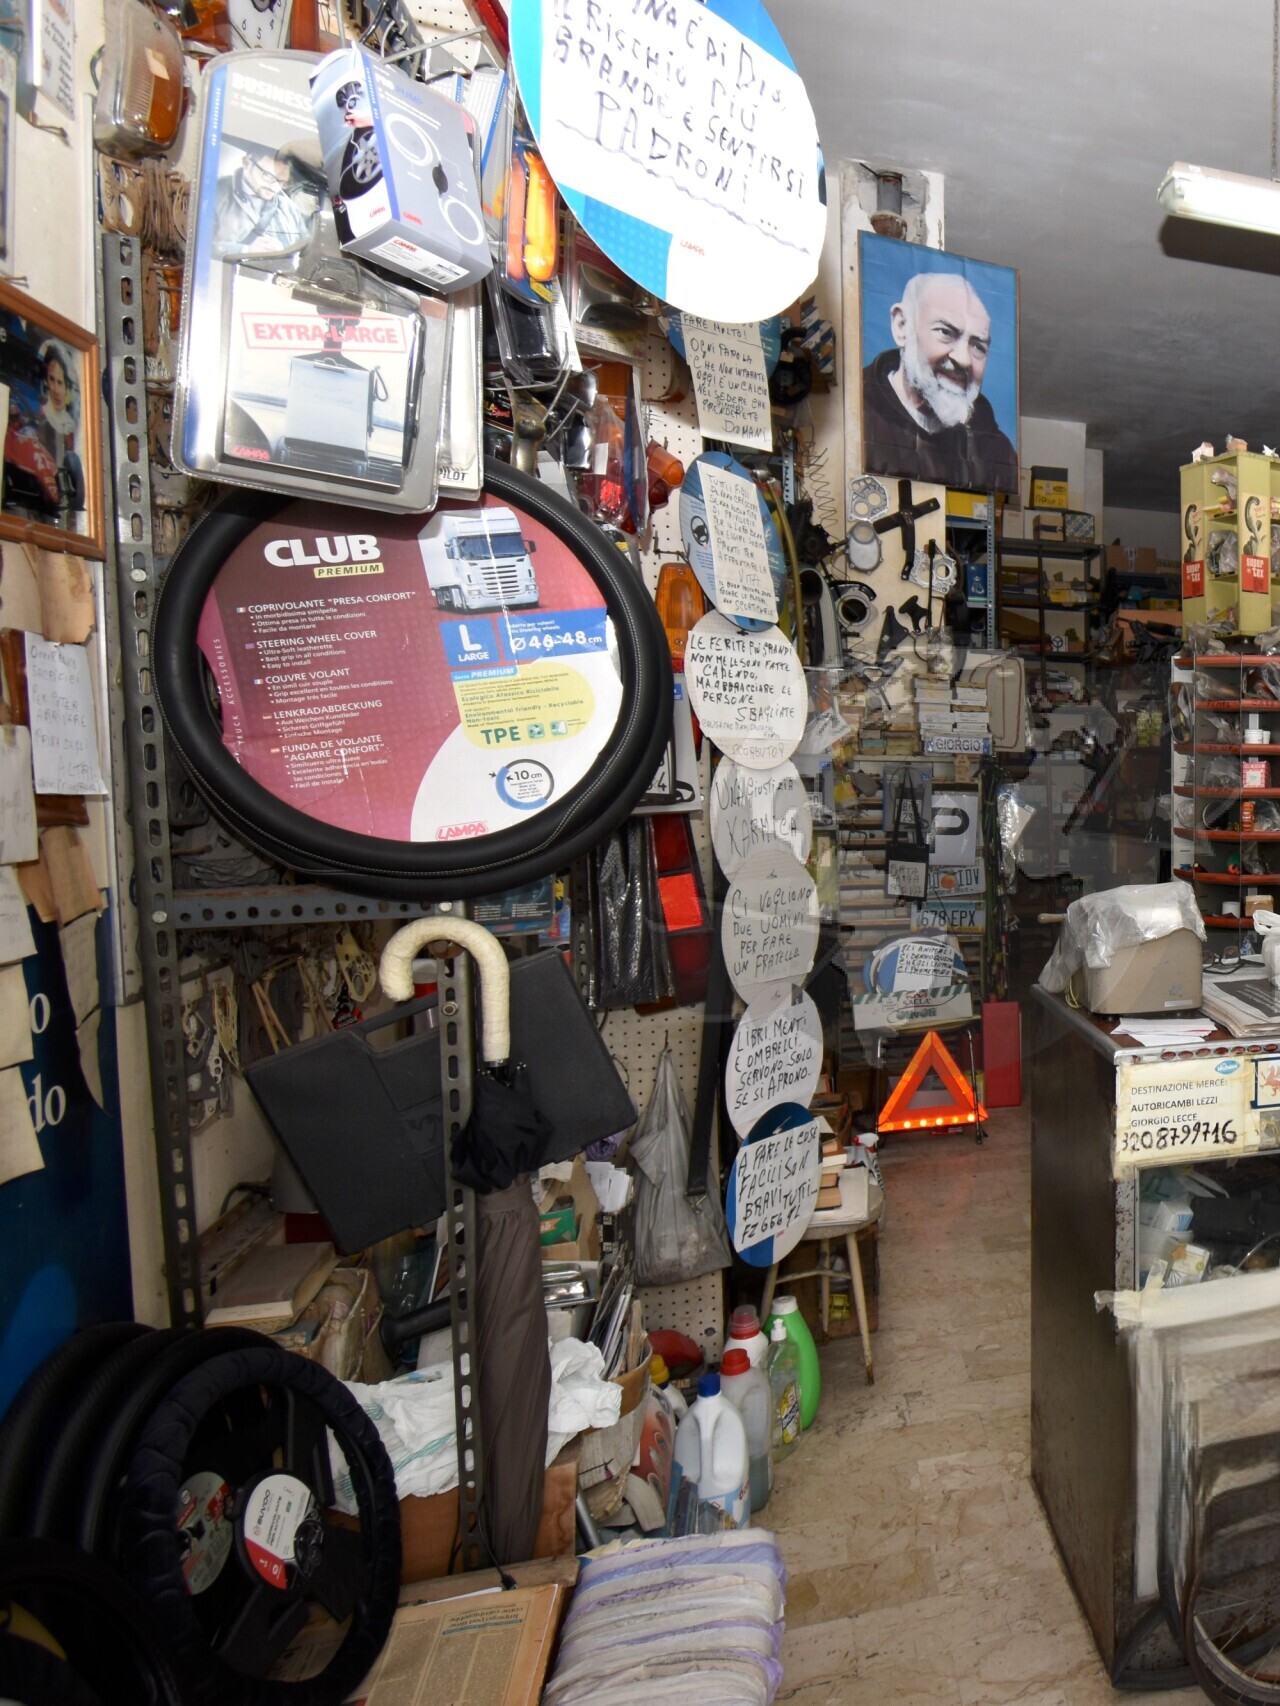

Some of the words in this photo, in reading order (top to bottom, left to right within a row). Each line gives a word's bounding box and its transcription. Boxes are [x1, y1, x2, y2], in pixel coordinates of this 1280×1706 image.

[705, 114, 804, 199] SENTIRSI
[252, 322, 399, 344] EXTRA-LARGE
[263, 534, 381, 568] CLUB
[317, 564, 380, 576] PREMIUM
[248, 599, 326, 614] COPRIVOLANTE
[256, 638, 304, 649] STEERING
[306, 634, 342, 646] WHEEL
[343, 630, 377, 640] COVER
[458, 624, 482, 651] L
[690, 636, 705, 650] LE
[710, 637, 745, 651] FERITE
[458, 652, 489, 662] LARGE
[691, 653, 713, 663] NON
[765, 661, 790, 671] FATTE
[265, 673, 306, 684] COUVRE
[308, 668, 350, 680] VOLANT
[703, 692, 754, 704] PERSONE
[273, 700, 383, 719] LENKRADABDECKUNG
[281, 742, 318, 754] FUNDA
[320, 740, 334, 749] DE
[336, 734, 383, 747] VOLANTE
[480, 725, 521, 745] TPE
[936, 738, 980, 751] GIORGIO
[514, 770, 529, 780] 10
[436, 821, 488, 841] LAMPA
[727, 817, 798, 857] KARMICA
[759, 887, 812, 913] VOGLIONO
[733, 921, 752, 938] DUE
[760, 910, 805, 934] UOMINI
[921, 911, 947, 926] 678
[952, 911, 976, 926] EPX
[740, 940, 758, 959] PER
[762, 935, 793, 951] FARE
[733, 960, 749, 976] UN
[754, 947, 800, 978] FRATELLO
[736, 1060, 784, 1093] SERVONO
[1131, 1081, 1194, 1095] DESTINAZIONE
[1196, 1078, 1228, 1089] MERCE:
[1131, 1099, 1194, 1113] AUTORICAMBI
[1196, 1097, 1218, 1106] LEZZI
[1131, 1116, 1170, 1128] GIORGIO
[1173, 1113, 1197, 1123] LECCE
[743, 1188, 783, 1222] BRAVI
